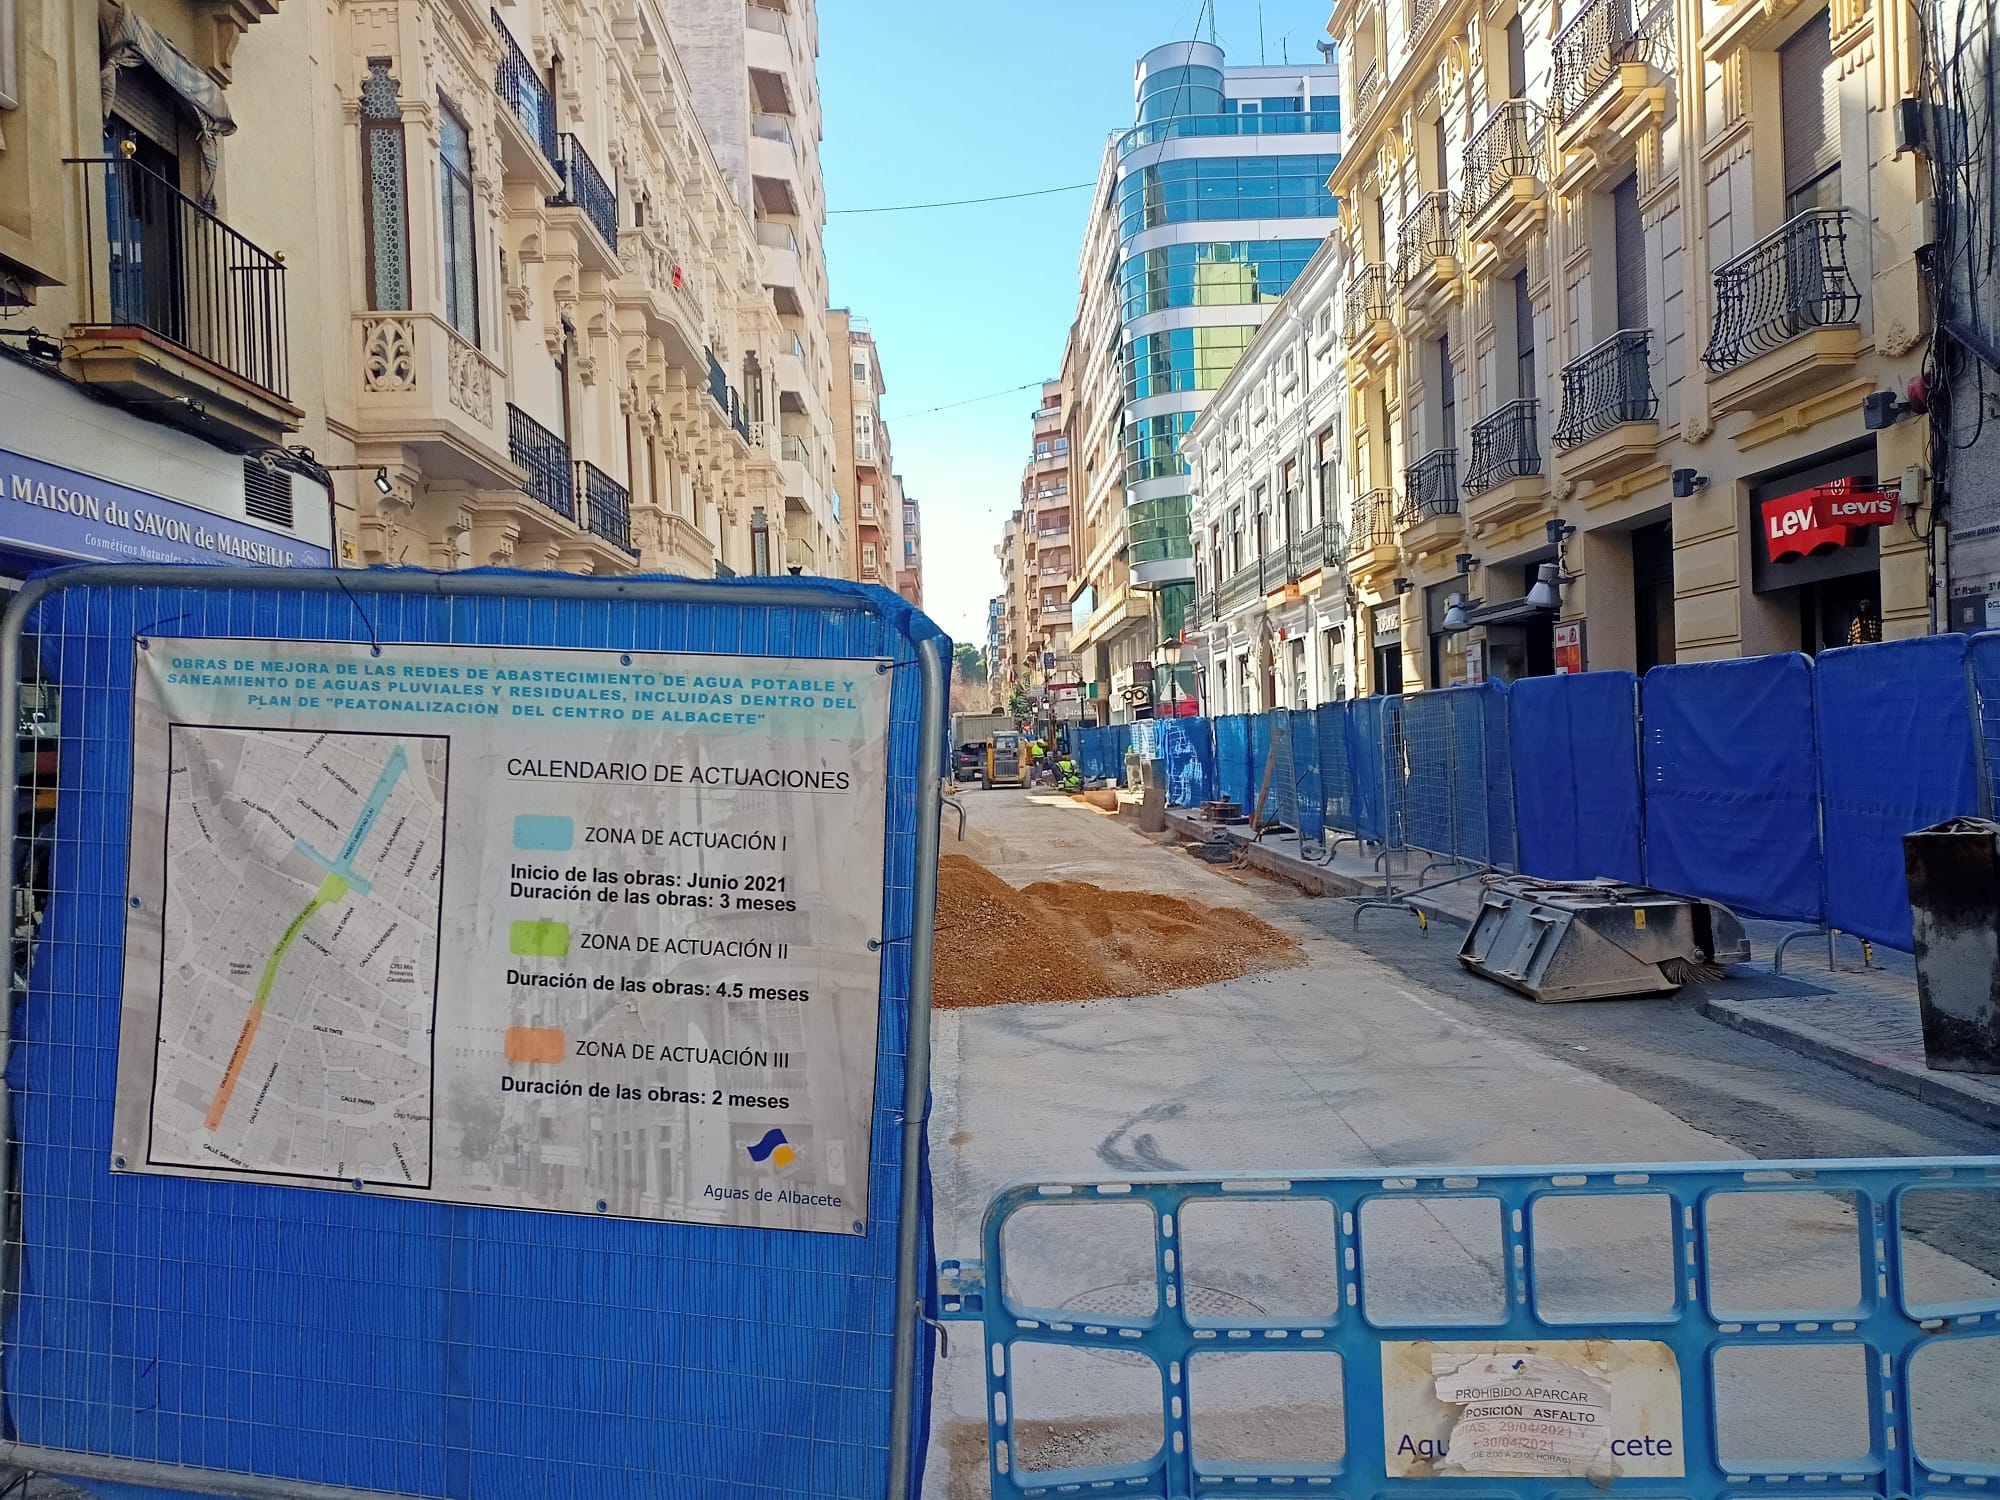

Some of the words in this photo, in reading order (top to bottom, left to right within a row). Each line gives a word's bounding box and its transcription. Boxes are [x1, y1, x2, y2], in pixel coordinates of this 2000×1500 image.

[10, 474, 99, 521] MAISON
[105, 501, 129, 529] du
[134, 509, 191, 544] SAVON
[195, 526, 214, 551] de
[217, 532, 294, 567] MARSEILLE
[1771, 505, 1818, 538] Lev
[85, 533, 138, 556] Cosméticos
[172, 657, 227, 670] OBRAS
[233, 659, 255, 671] DE
[261, 660, 329, 675] MEJORA
[336, 663, 358, 675] DE
[364, 664, 396, 677] LAS
[403, 666, 459, 679] REDES
[466, 668, 488, 680] DE
[496, 669, 656, 686] ABASTECIMIENTO
[663, 675, 686, 687] DE
[693, 676, 743, 689] AGUA
[751, 678, 835, 692] POTABLE
[843, 681, 855, 692] Y
[167, 673, 289, 689] SANEAMIENTO
[295, 677, 316, 690] DE
[323, 679, 381, 692] AGUAS
[388, 681, 484, 696] PLUVIALES
[491, 685, 502, 696] Y
[509, 686, 627, 703] RESIDUALES,
[634, 690, 732, 705] INCLUIDAS
[741, 694, 814, 708] DENTRO
[822, 697, 856, 710] DEL
[248, 694, 292, 707] PLAN
[298, 697, 320, 708] DE
[512, 705, 545, 717] DEL
[552, 706, 624, 720] CENTRO
[631, 708, 654, 720] DE
[662, 710, 766, 724] ALBACETE"
[303, 744, 317, 760] CALLE
[321, 762, 336, 776] CALLE
[506, 758, 647, 781] CALENDARIO
[654, 764, 683, 783] DE
[689, 765, 850, 790] ACTUACIONES
[190, 802, 202, 818] CALLE
[241, 796, 257, 810] CALLE
[296, 797, 312, 810] CALLE
[377, 846, 390, 863] CALLE
[386, 816, 406, 847] SALAMANCA
[584, 827, 637, 845] ZONA
[641, 830, 664, 846] DE
[669, 830, 777, 851] ACTUACIÓN
[781, 836, 787, 851] I
[404, 861, 415, 878] CALLE
[510, 863, 559, 881] Inicio
[564, 866, 587, 883] de
[592, 867, 618, 884] las
[623, 868, 682, 887] obras:
[686, 873, 739, 890] Junio
[744, 876, 786, 892] 2021
[510, 882, 591, 902] Duración
[597, 885, 619, 903] de
[623, 887, 650, 904] las
[656, 889, 714, 908] obras:
[719, 893, 730, 909] 3
[736, 897, 797, 912] meses
[302, 933, 317, 946] CALLE
[331, 925, 343, 941] CALLE
[580, 933, 631, 952] ZONA
[636, 936, 659, 953] DE
[664, 938, 773, 959] ACTUACIÓN
[778, 943, 788, 960] II
[358, 952, 373, 969] CALLE
[506, 969, 587, 990] Duración
[593, 974, 615, 991] de
[620, 976, 646, 993] las
[652, 978, 711, 997] obras:
[716, 982, 743, 999] 4.5
[749, 986, 809, 1002] meses
[575, 1040, 627, 1059] ZONA
[631, 1044, 654, 1061] DE
[659, 1046, 768, 1068] ACTUACIÓN
[773, 1051, 790, 1069] III
[219, 1072, 230, 1089] CALLE
[340, 1095, 356, 1103] CALLE
[501, 1076, 583, 1097] Duración
[588, 1082, 610, 1099] de
[616, 1083, 642, 1101] las
[648, 1085, 706, 1104] obras:
[712, 1090, 723, 1106] 2
[728, 1094, 790, 1109] meses
[248, 1107, 260, 1124] CALLE
[203, 1143, 219, 1155] CALLE
[392, 1142, 403, 1159] CALLE
[704, 1184, 749, 1201] Aguas
[755, 1187, 773, 1202] de
[777, 1189, 842, 1207] Albacete
[1455, 1387, 1521, 1399] PROHIBIDO
[1525, 1388, 1588, 1402] APARCAR
[1464, 1404, 1523, 1418] POSICIÓN
[1534, 1408, 1595, 1422] ASFALTO
[1499, 1421, 1572, 1437] 29/04/2021
[1397, 1434, 1450, 1458] Agu
[1611, 1435, 1672, 1456] cete
[1482, 1437, 1554, 1451] 30/04/2021
